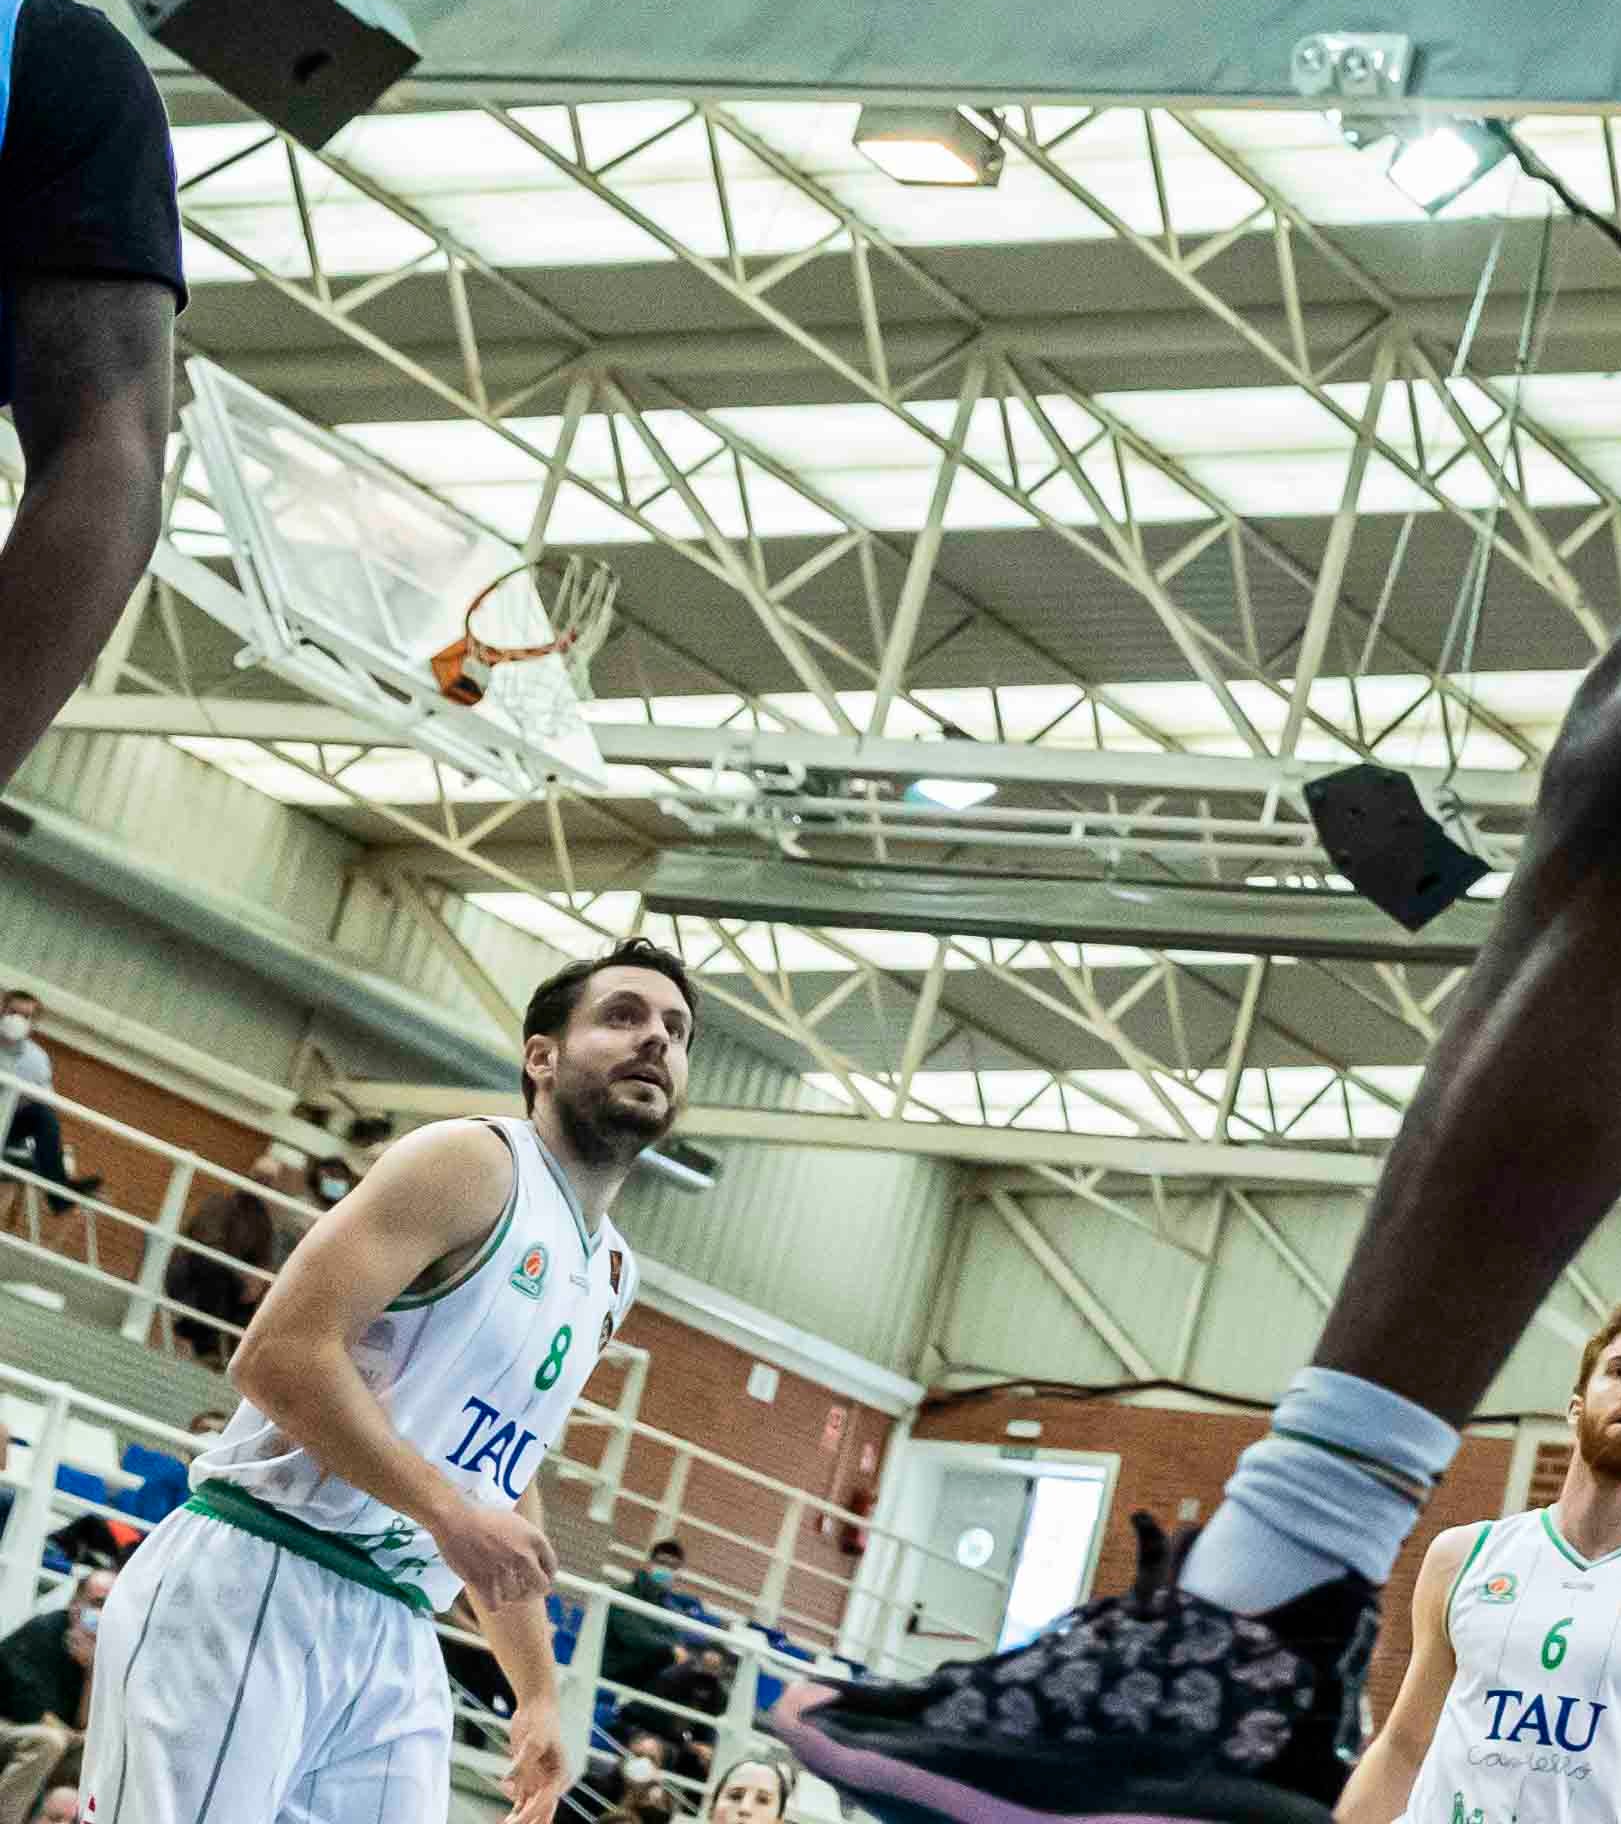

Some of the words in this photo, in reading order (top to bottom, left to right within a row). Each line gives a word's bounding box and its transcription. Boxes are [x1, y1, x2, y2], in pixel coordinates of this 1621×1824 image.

[534, 1323, 574, 1391] 8
[445, 1395, 538, 1501] TAU
[1541, 1616, 1575, 1671] 6
[1484, 1689, 1608, 1753] TAU
